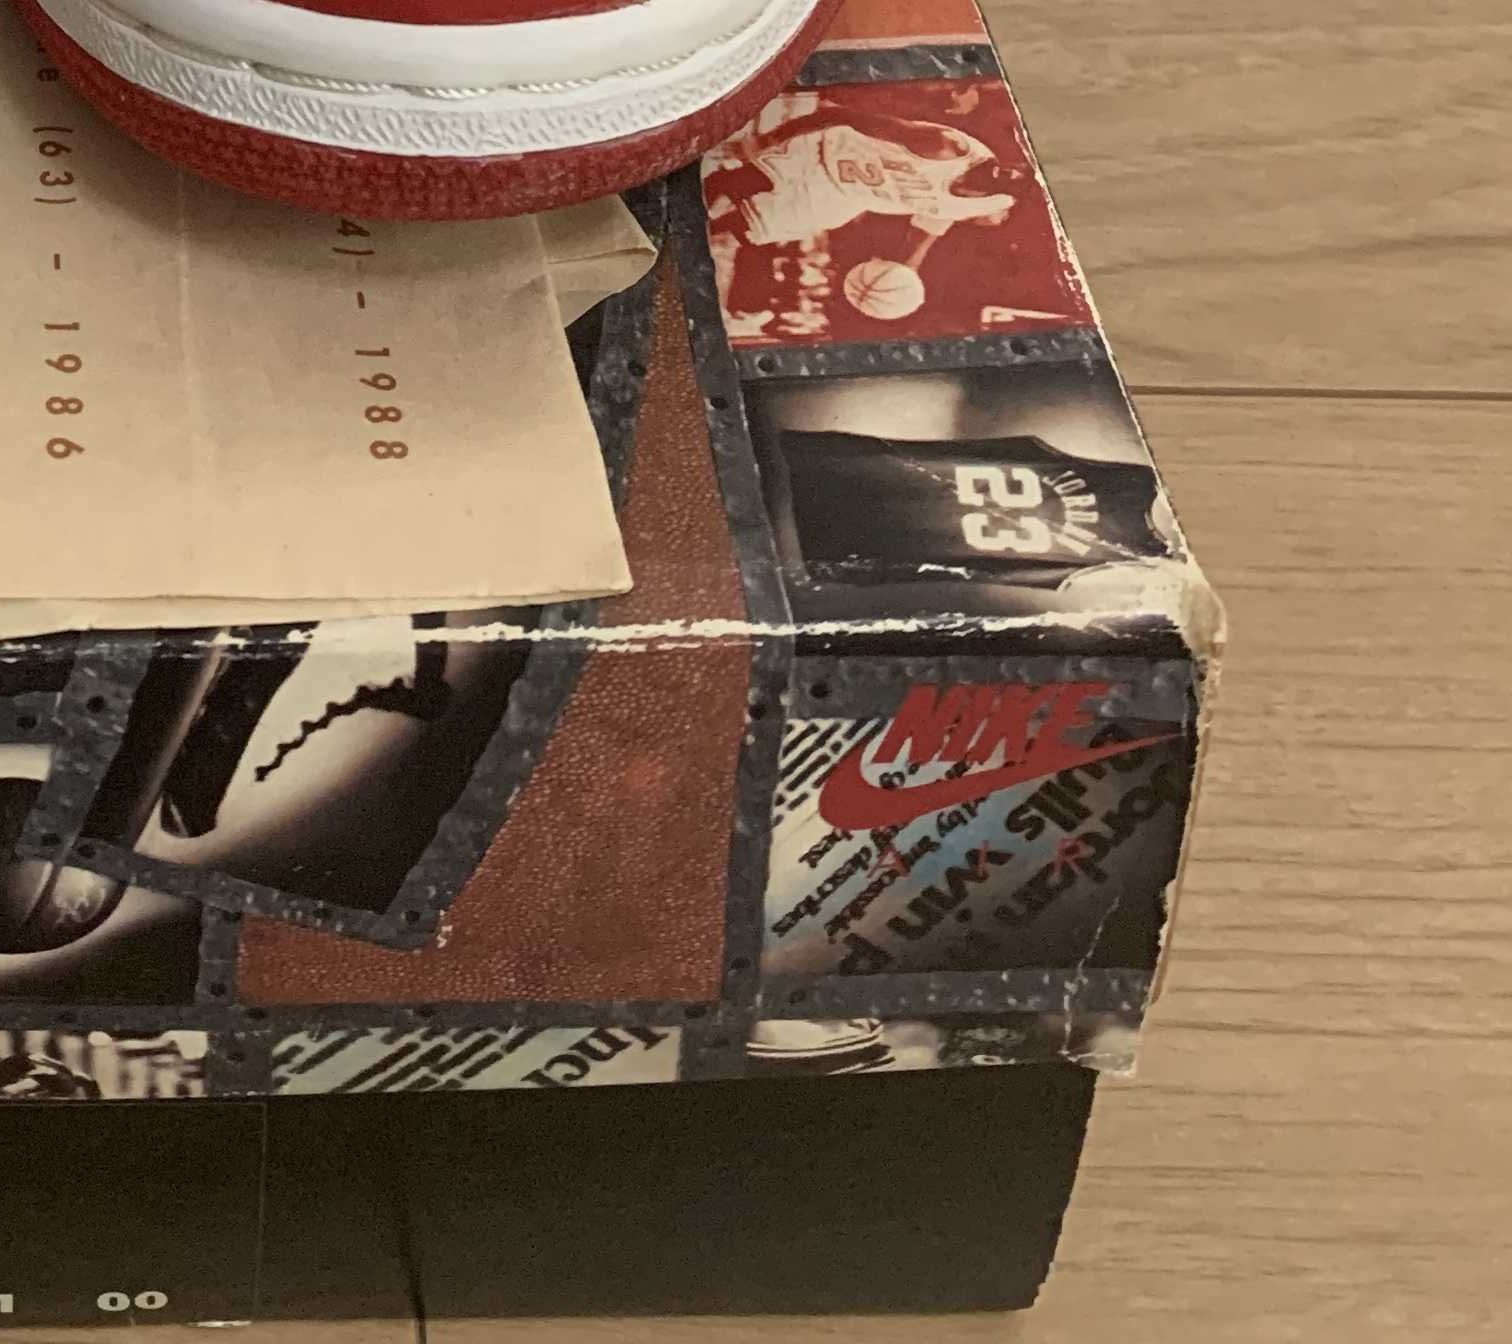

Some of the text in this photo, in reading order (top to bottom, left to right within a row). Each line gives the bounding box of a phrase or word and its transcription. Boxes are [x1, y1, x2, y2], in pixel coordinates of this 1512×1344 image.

[32, 125, 78, 204] (63)
[43, 320, 85, 460] 1986
[353, 345, 410, 461] 1988
[954, 465, 1052, 554] 23
[870, 682, 1118, 765] NIKE
[886, 847, 1015, 939] win
[96, 1290, 169, 1313] 00
